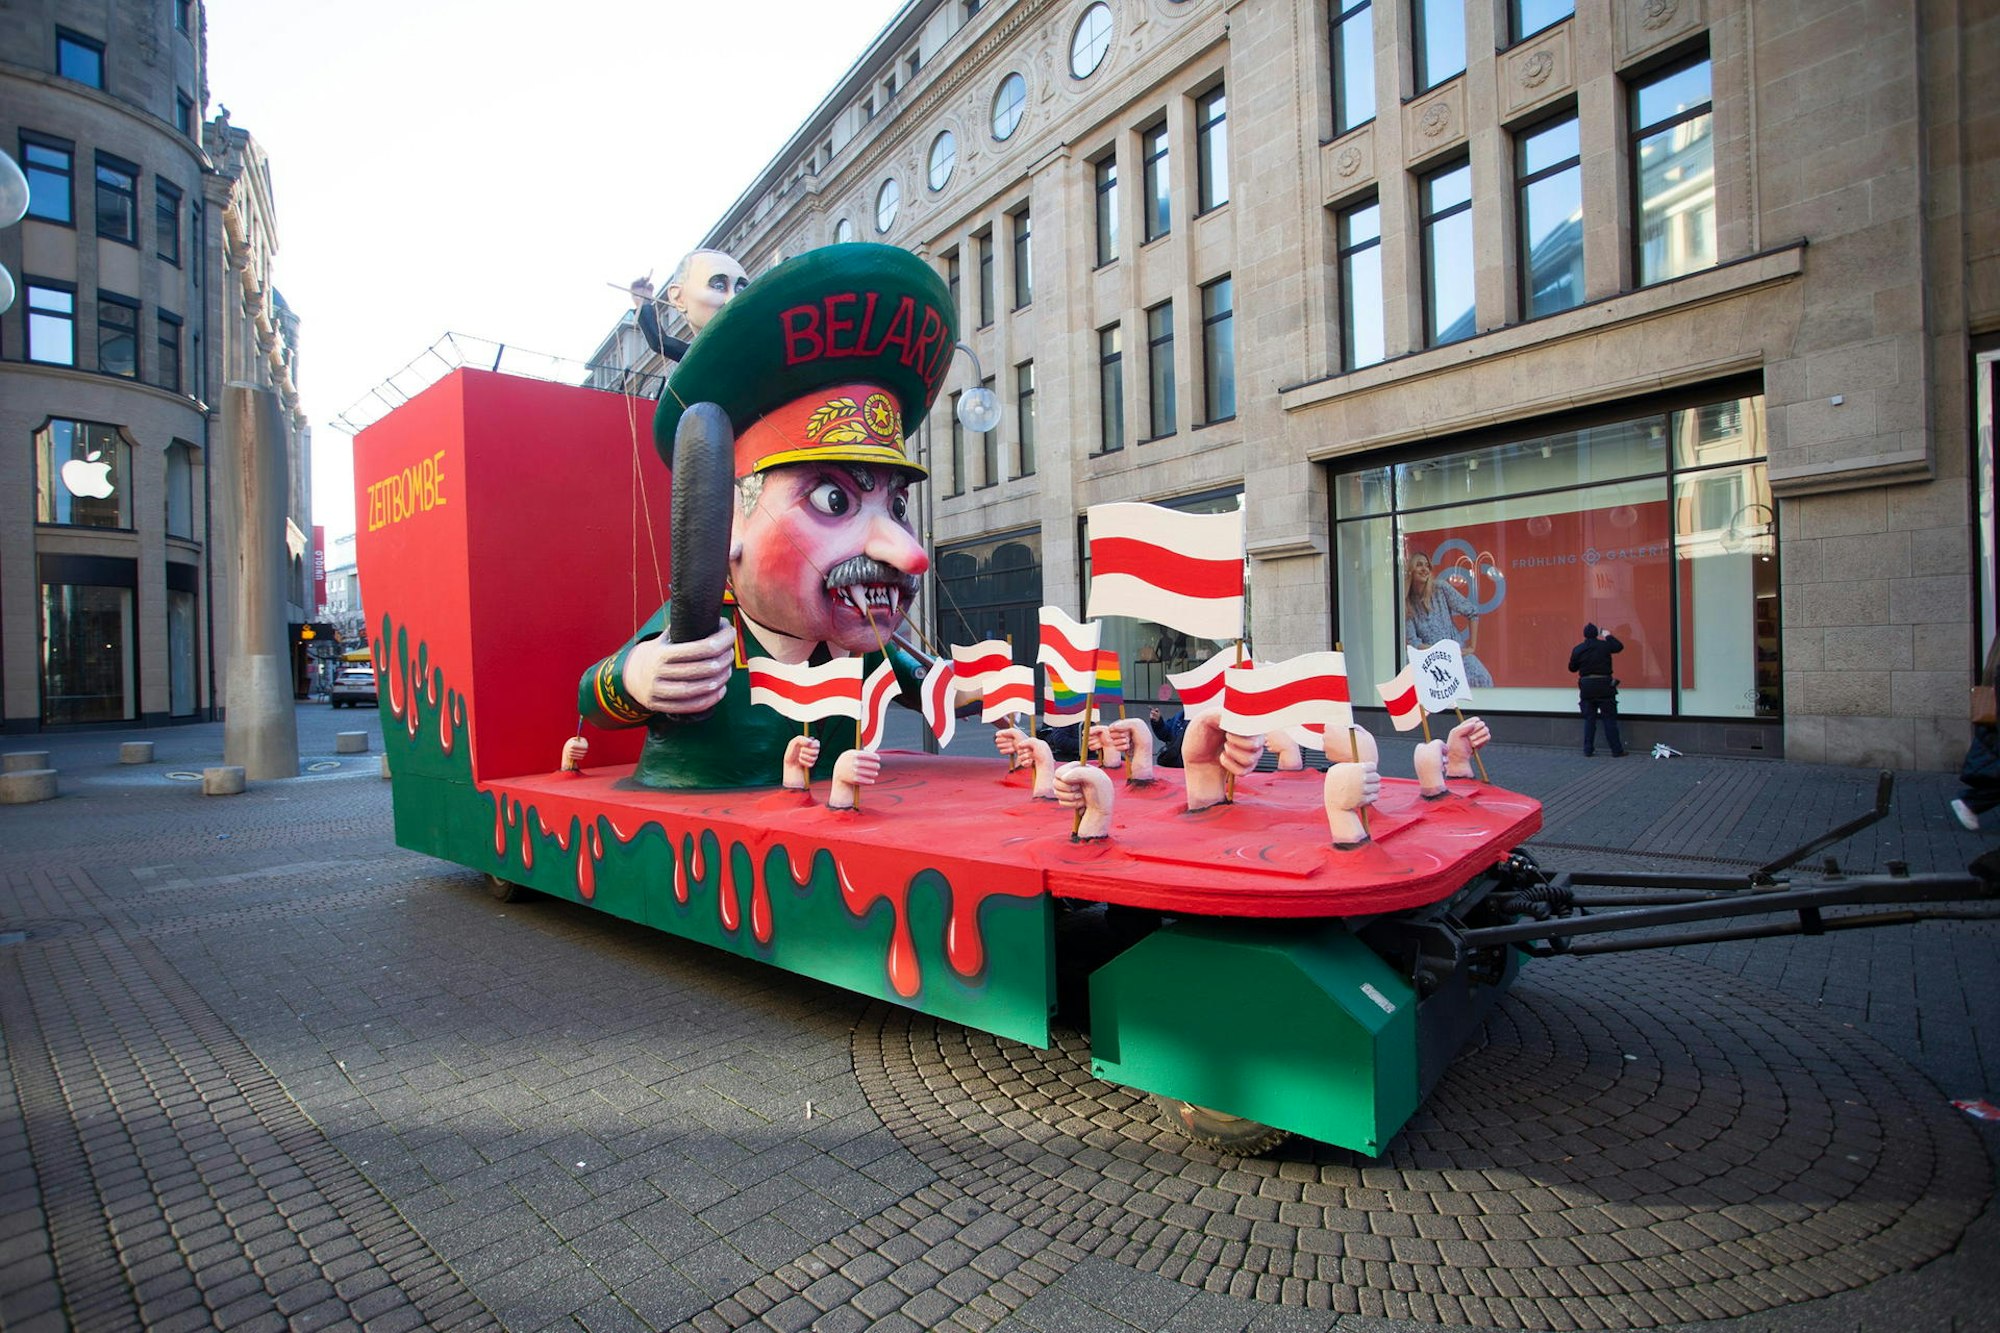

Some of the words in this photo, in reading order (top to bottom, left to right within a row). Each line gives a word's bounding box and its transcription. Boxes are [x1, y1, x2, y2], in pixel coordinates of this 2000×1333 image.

[368, 449, 447, 532] ZEITBOMBE
[314, 550, 324, 581] UNIQLO
[1512, 554, 1577, 569] FRÜHLING
[1606, 545, 1668, 560] GALERI
[1421, 651, 1452, 673] REFUGEES
[1429, 677, 1461, 699] WELCOME
